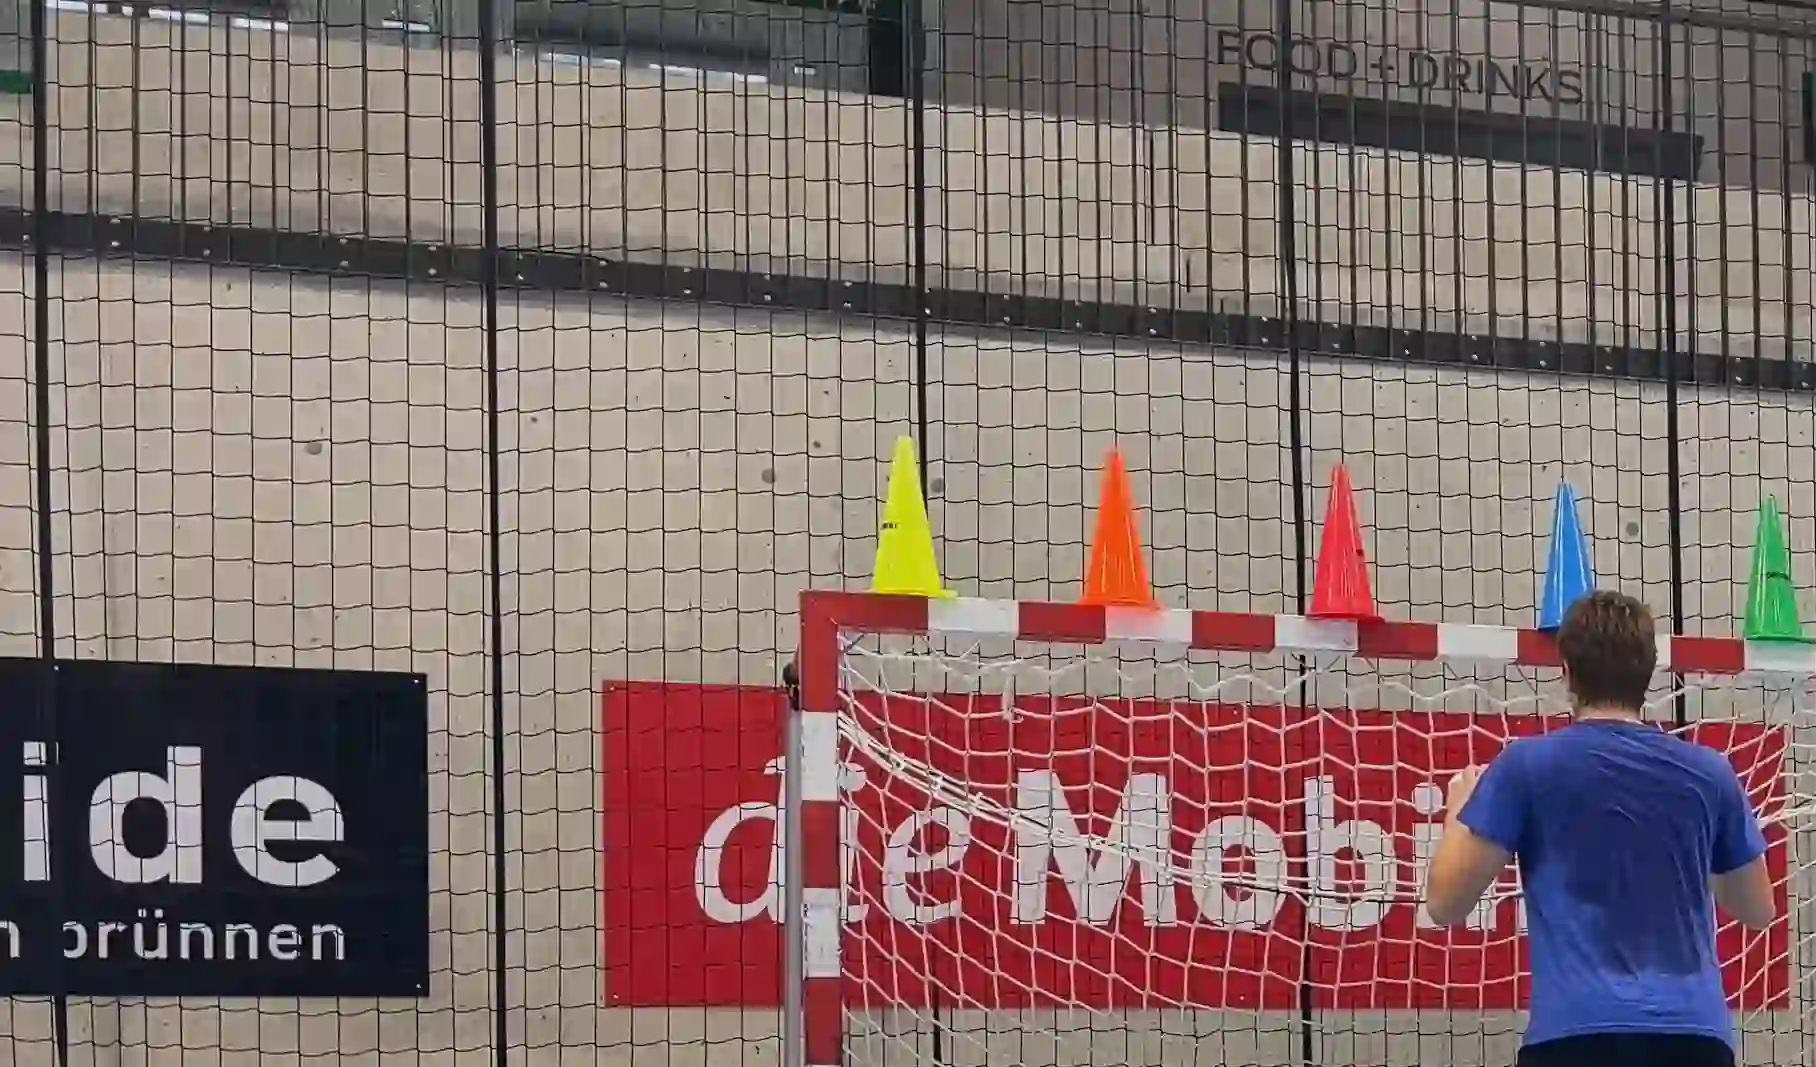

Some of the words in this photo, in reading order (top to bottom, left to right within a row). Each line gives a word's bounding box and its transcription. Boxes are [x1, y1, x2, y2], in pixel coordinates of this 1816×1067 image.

[1217, 29, 1358, 79] FOOD
[1408, 51, 1583, 104] DRINKS
[23, 741, 345, 887] ide
[1009, 768, 1528, 932] Mobi
